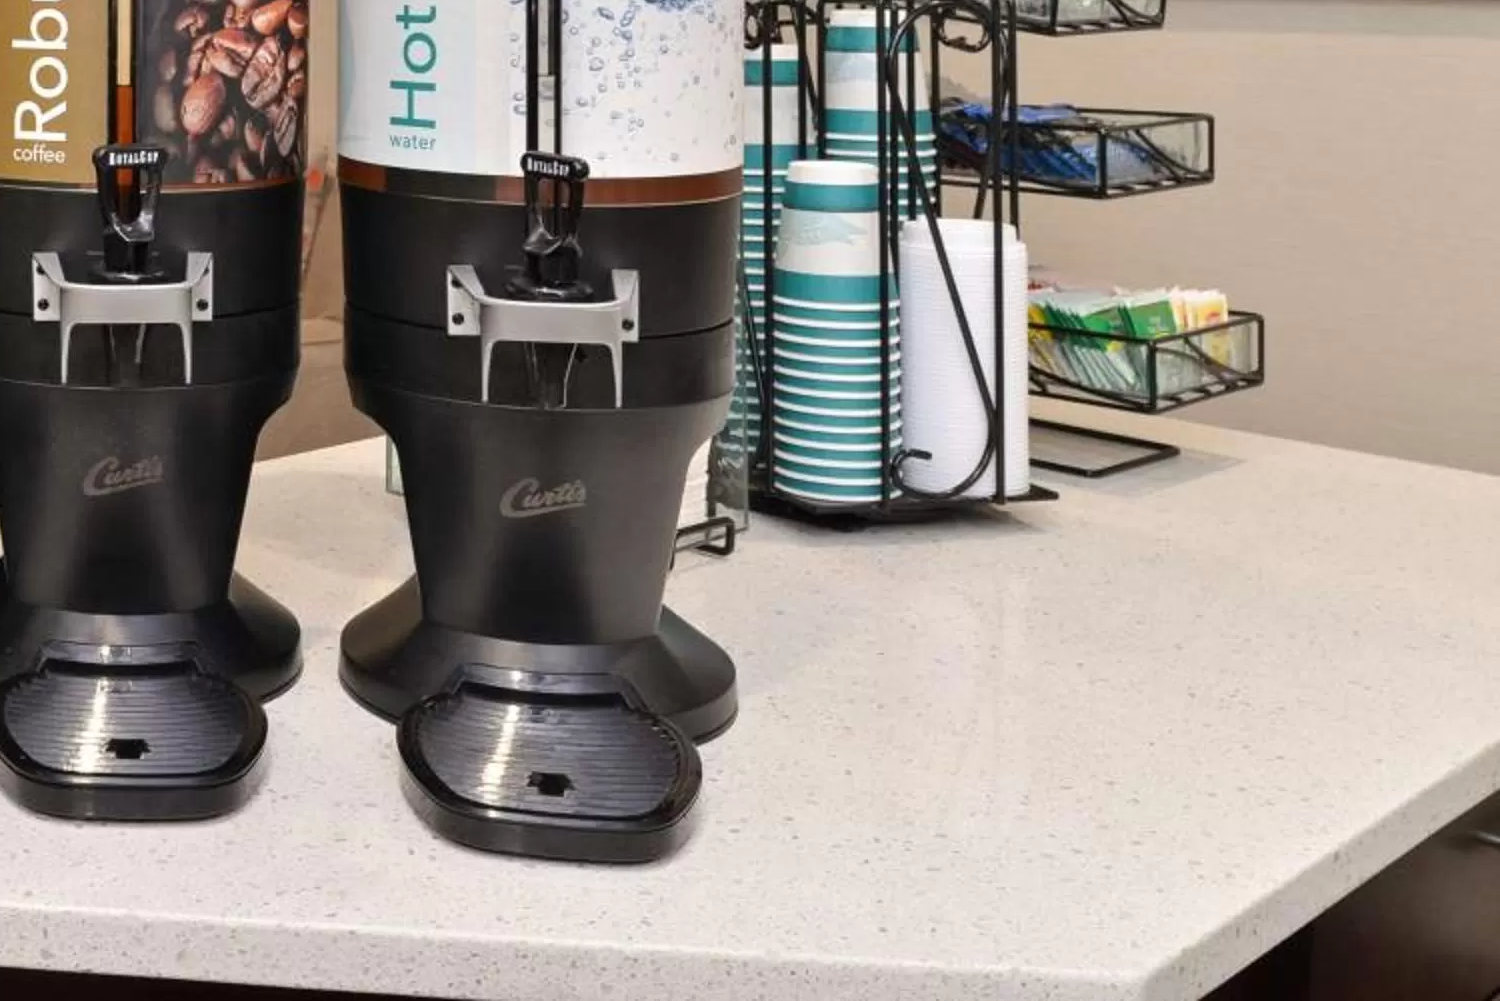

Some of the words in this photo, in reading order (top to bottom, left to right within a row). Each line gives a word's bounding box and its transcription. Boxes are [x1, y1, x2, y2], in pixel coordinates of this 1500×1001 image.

[389, 4, 437, 130] Hot
[13, 144, 66, 164] coffee
[389, 134, 436, 150] water
[83, 455, 164, 496] Curtis
[500, 478, 587, 518] Curtis
